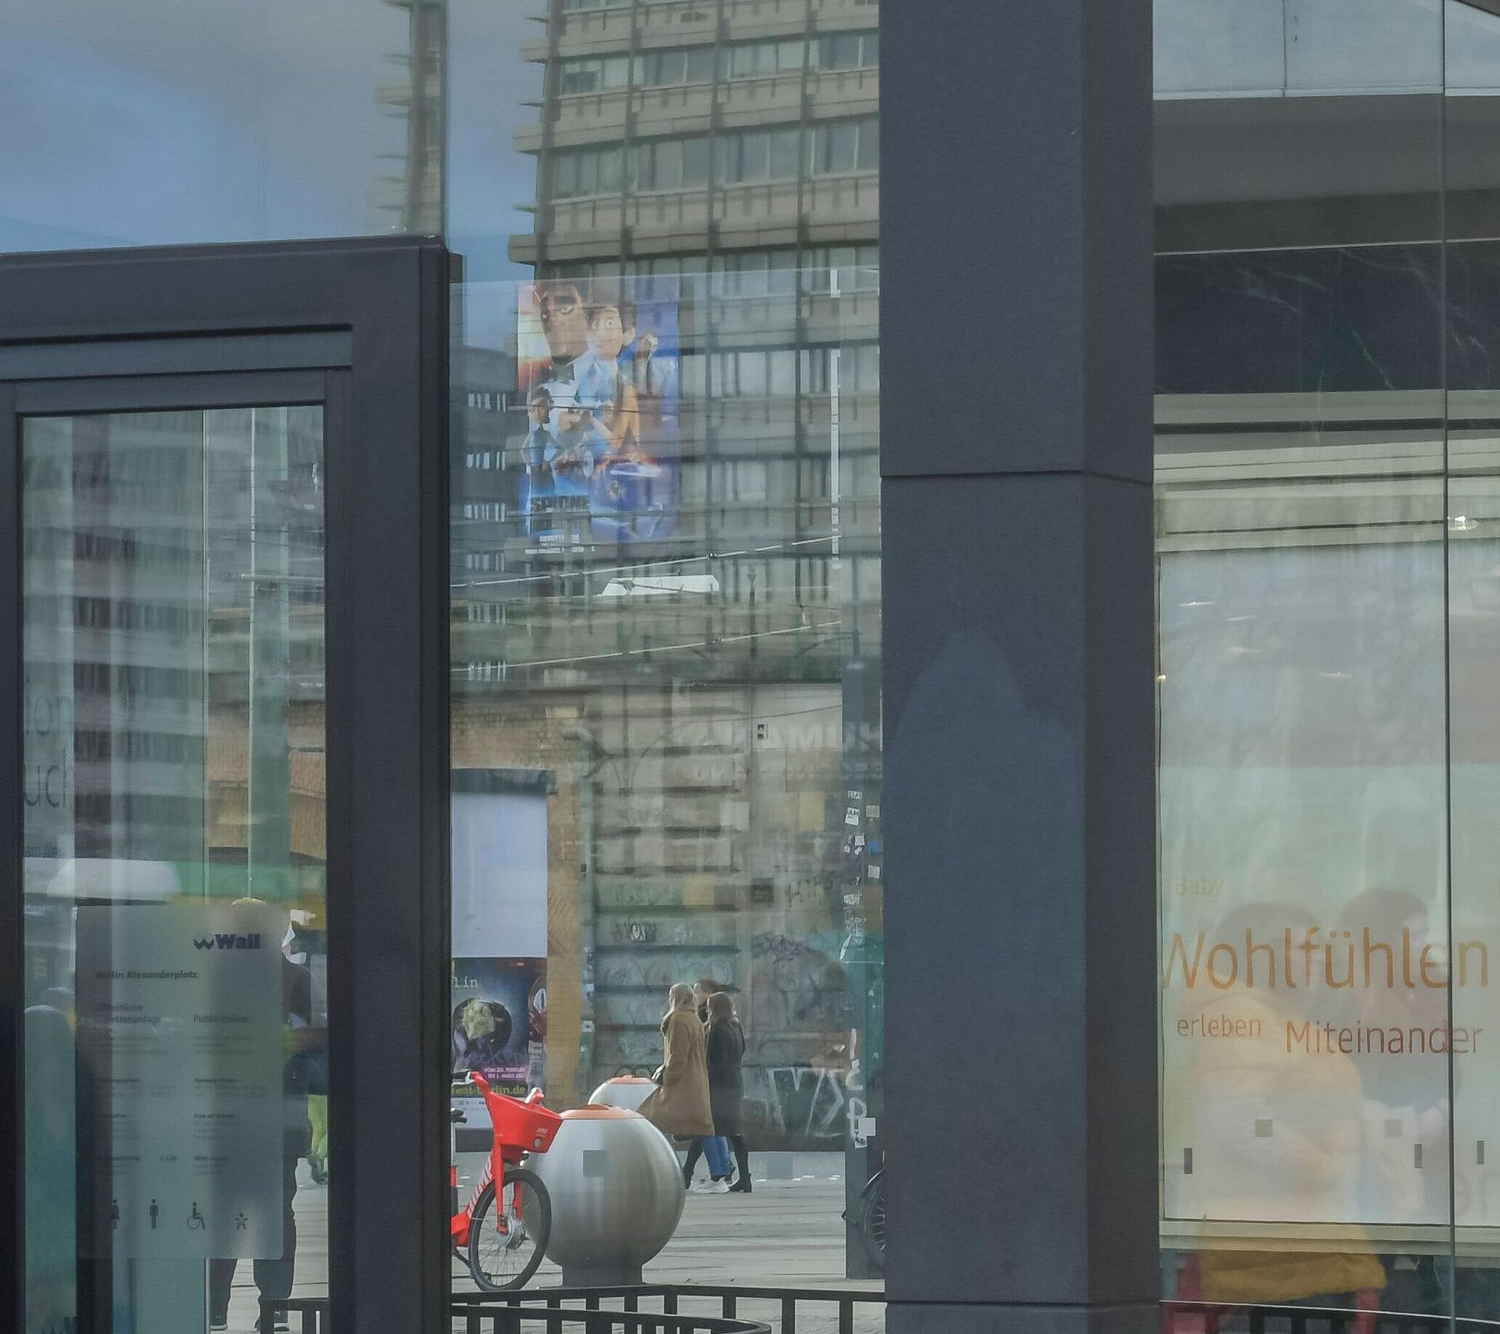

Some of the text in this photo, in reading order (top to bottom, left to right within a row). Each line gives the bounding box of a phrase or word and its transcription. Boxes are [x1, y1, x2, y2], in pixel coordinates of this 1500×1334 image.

[215, 933, 261, 950] Wall
[1161, 924, 1490, 990] Wohlfühlen
[1176, 1013, 1262, 1038] erleben
[1286, 1019, 1486, 1056] Miteinander
